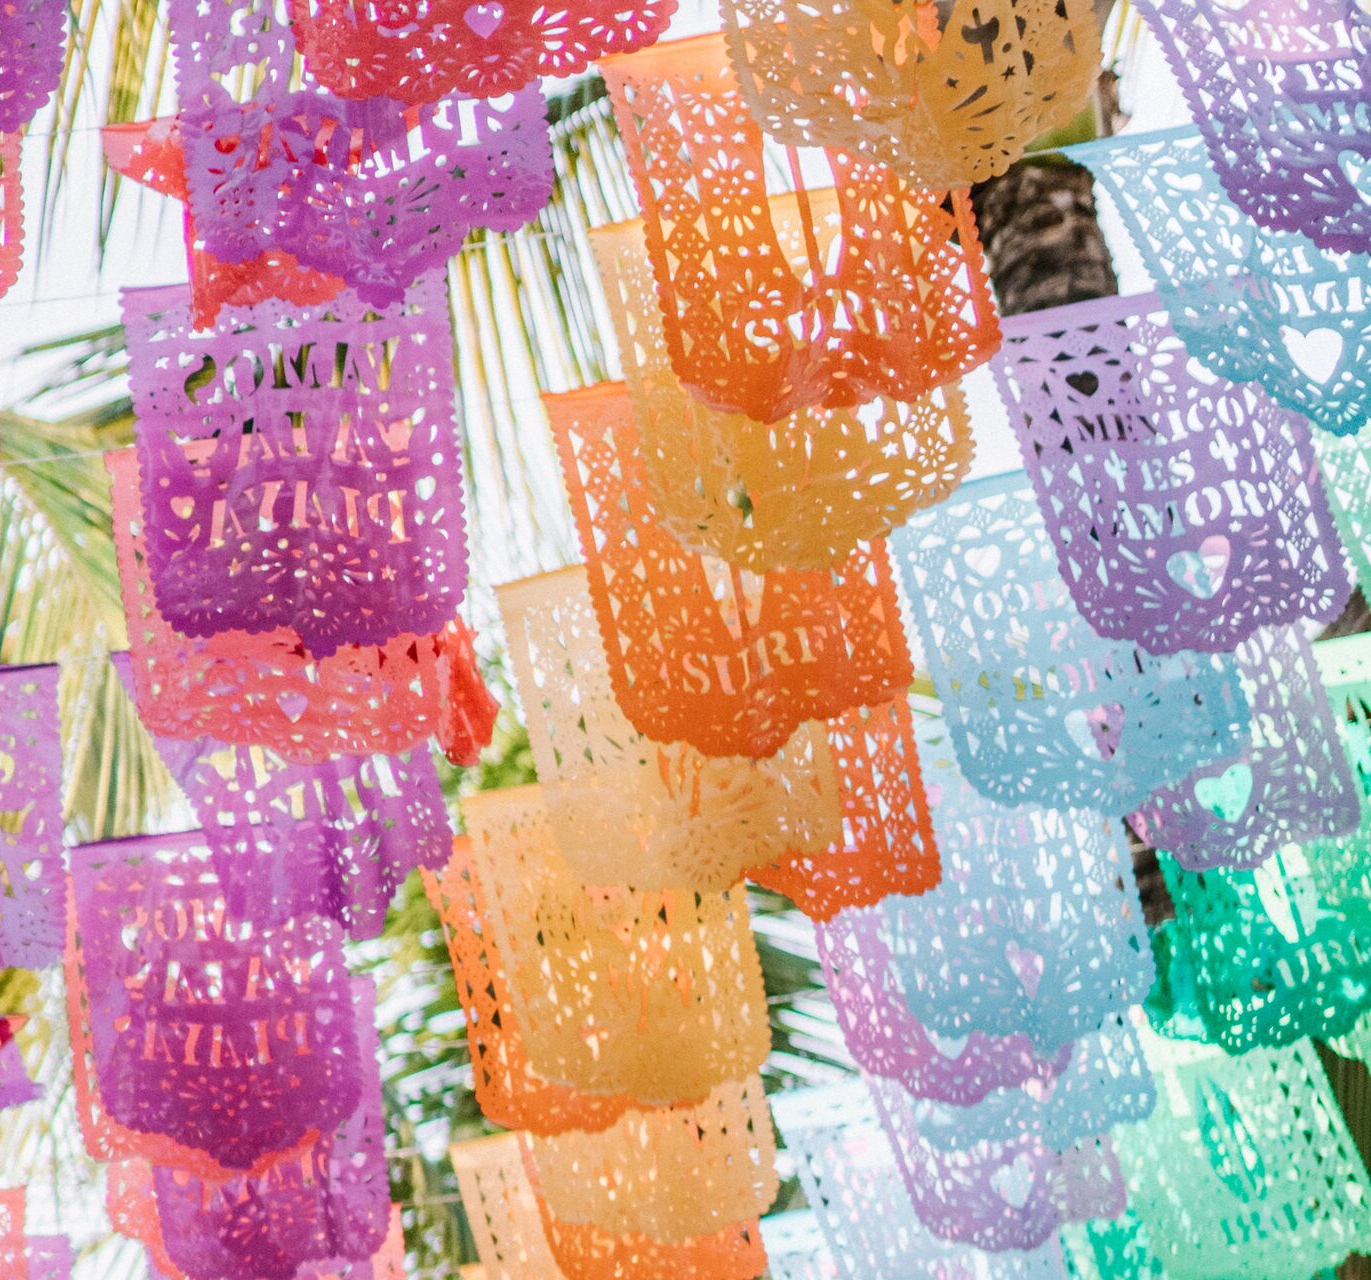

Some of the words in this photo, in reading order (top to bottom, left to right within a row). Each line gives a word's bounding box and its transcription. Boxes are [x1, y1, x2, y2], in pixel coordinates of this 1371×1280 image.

[1219, 19, 1371, 55] MEXIC
[1295, 59, 1363, 92] ES
[1268, 100, 1371, 136] AM
[1074, 395, 1244, 443] MEXICO
[1137, 448, 1196, 493] ES
[1111, 479, 1266, 541] AMOR
[682, 626, 828, 696] SURF
